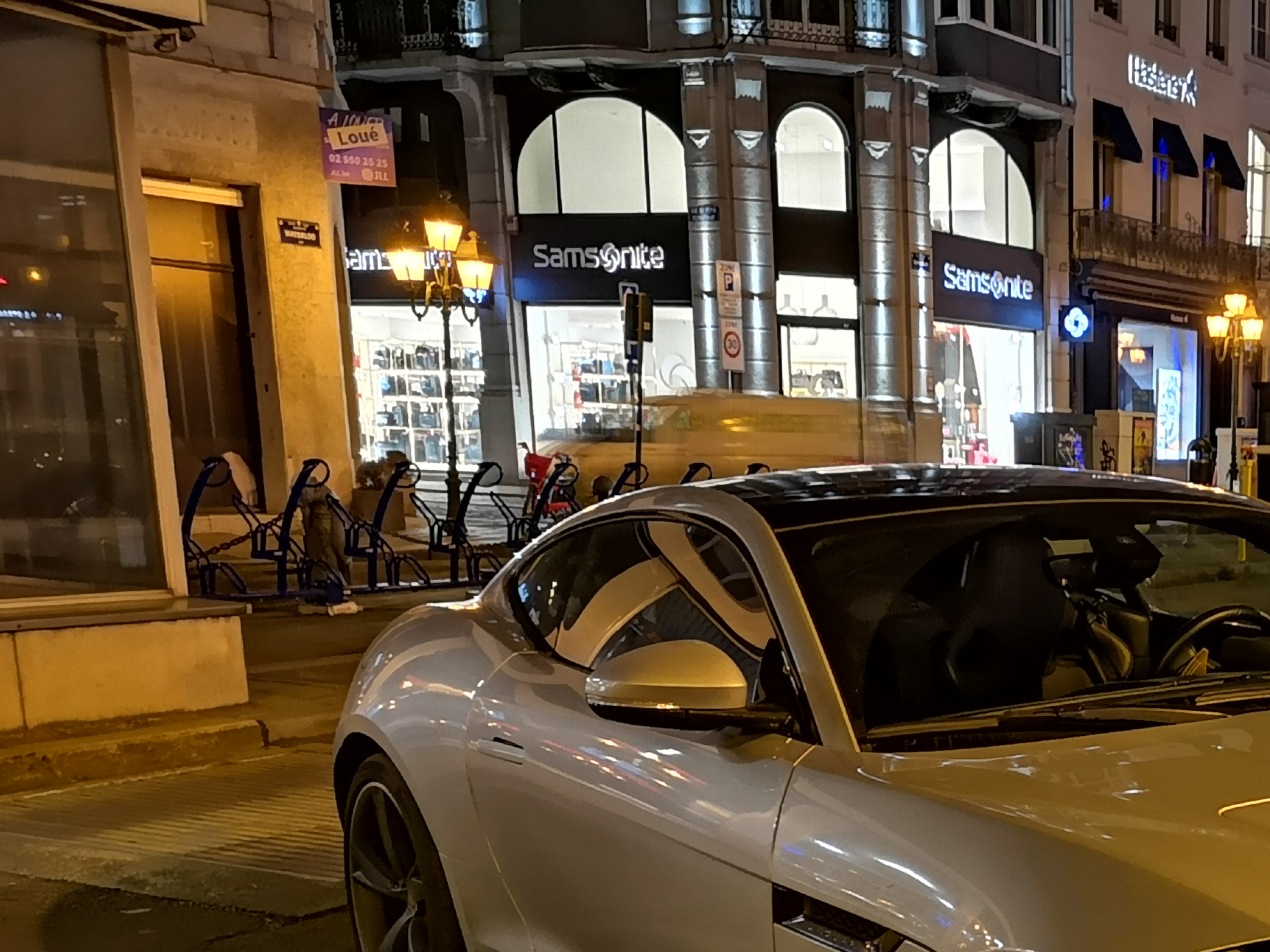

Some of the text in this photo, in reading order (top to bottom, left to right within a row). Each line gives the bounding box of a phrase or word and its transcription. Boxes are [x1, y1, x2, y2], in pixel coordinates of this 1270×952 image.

[337, 126, 379, 146] Loué
[329, 153, 342, 164] 02
[374, 171, 390, 182] JLL
[533, 242, 665, 273] Samsonite
[943, 261, 1035, 301] Samsonite
[727, 338, 738, 350] 30
